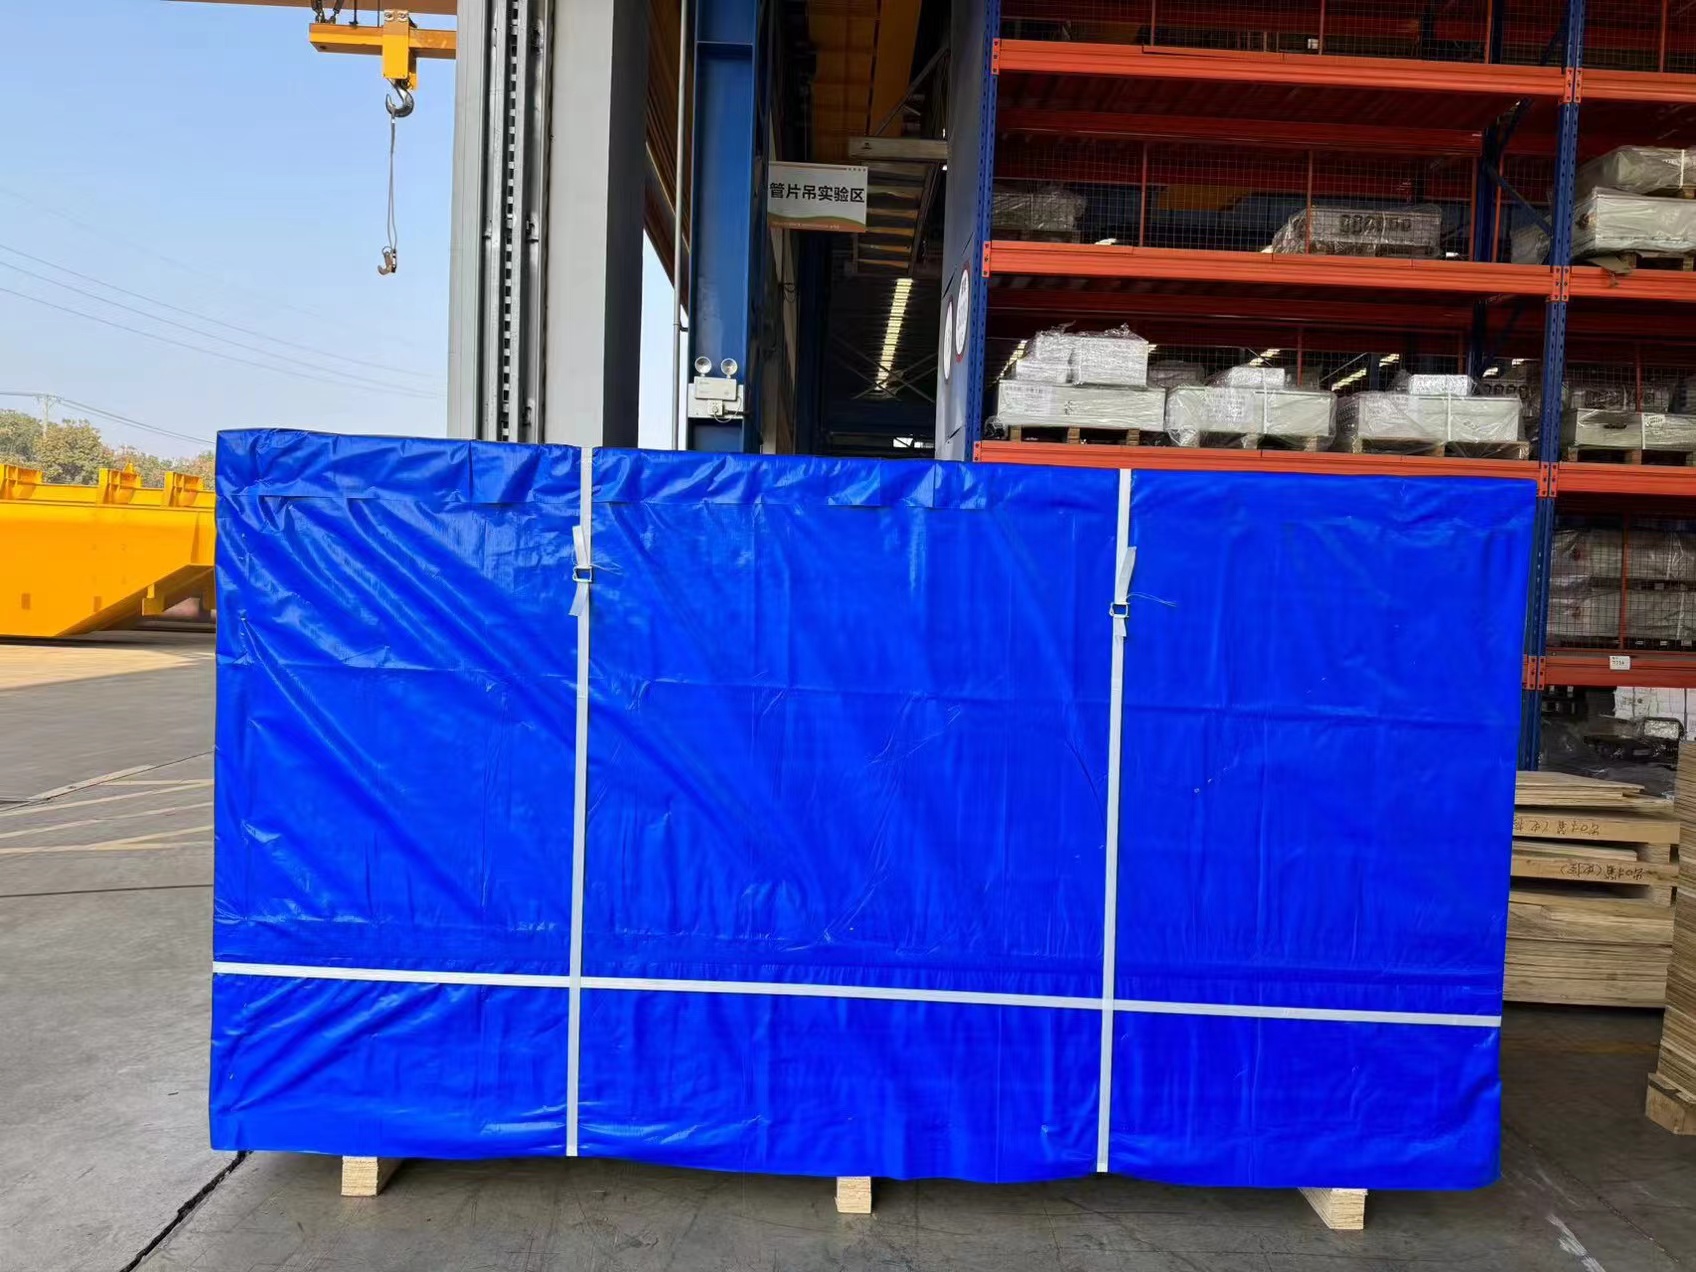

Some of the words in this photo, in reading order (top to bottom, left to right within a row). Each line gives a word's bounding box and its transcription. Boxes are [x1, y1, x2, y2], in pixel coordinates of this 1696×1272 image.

[769, 182, 865, 203] 管片吊实验区
